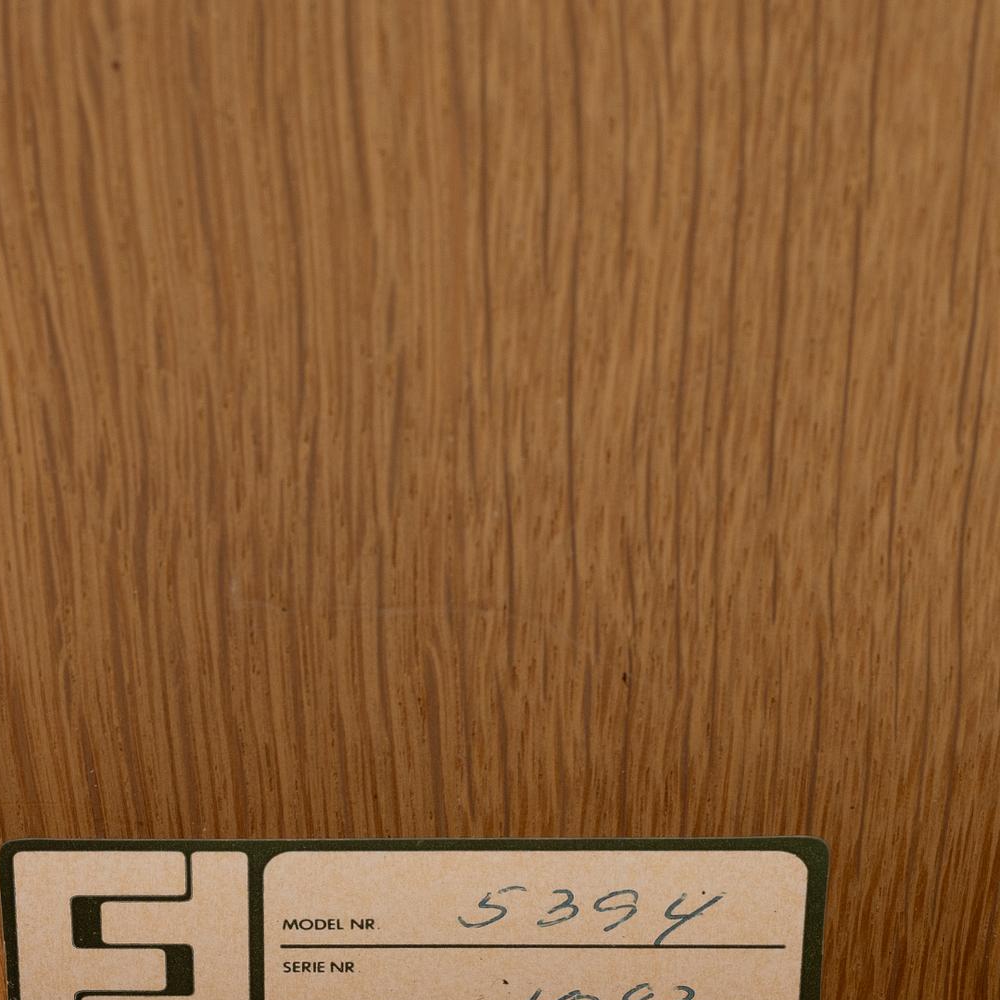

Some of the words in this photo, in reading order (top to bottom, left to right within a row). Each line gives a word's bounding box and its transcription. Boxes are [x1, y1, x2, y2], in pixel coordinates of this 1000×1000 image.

[457, 885, 726, 946] 5394
[282, 918, 344, 931] MODEL
[282, 961, 325, 973] SERIE
